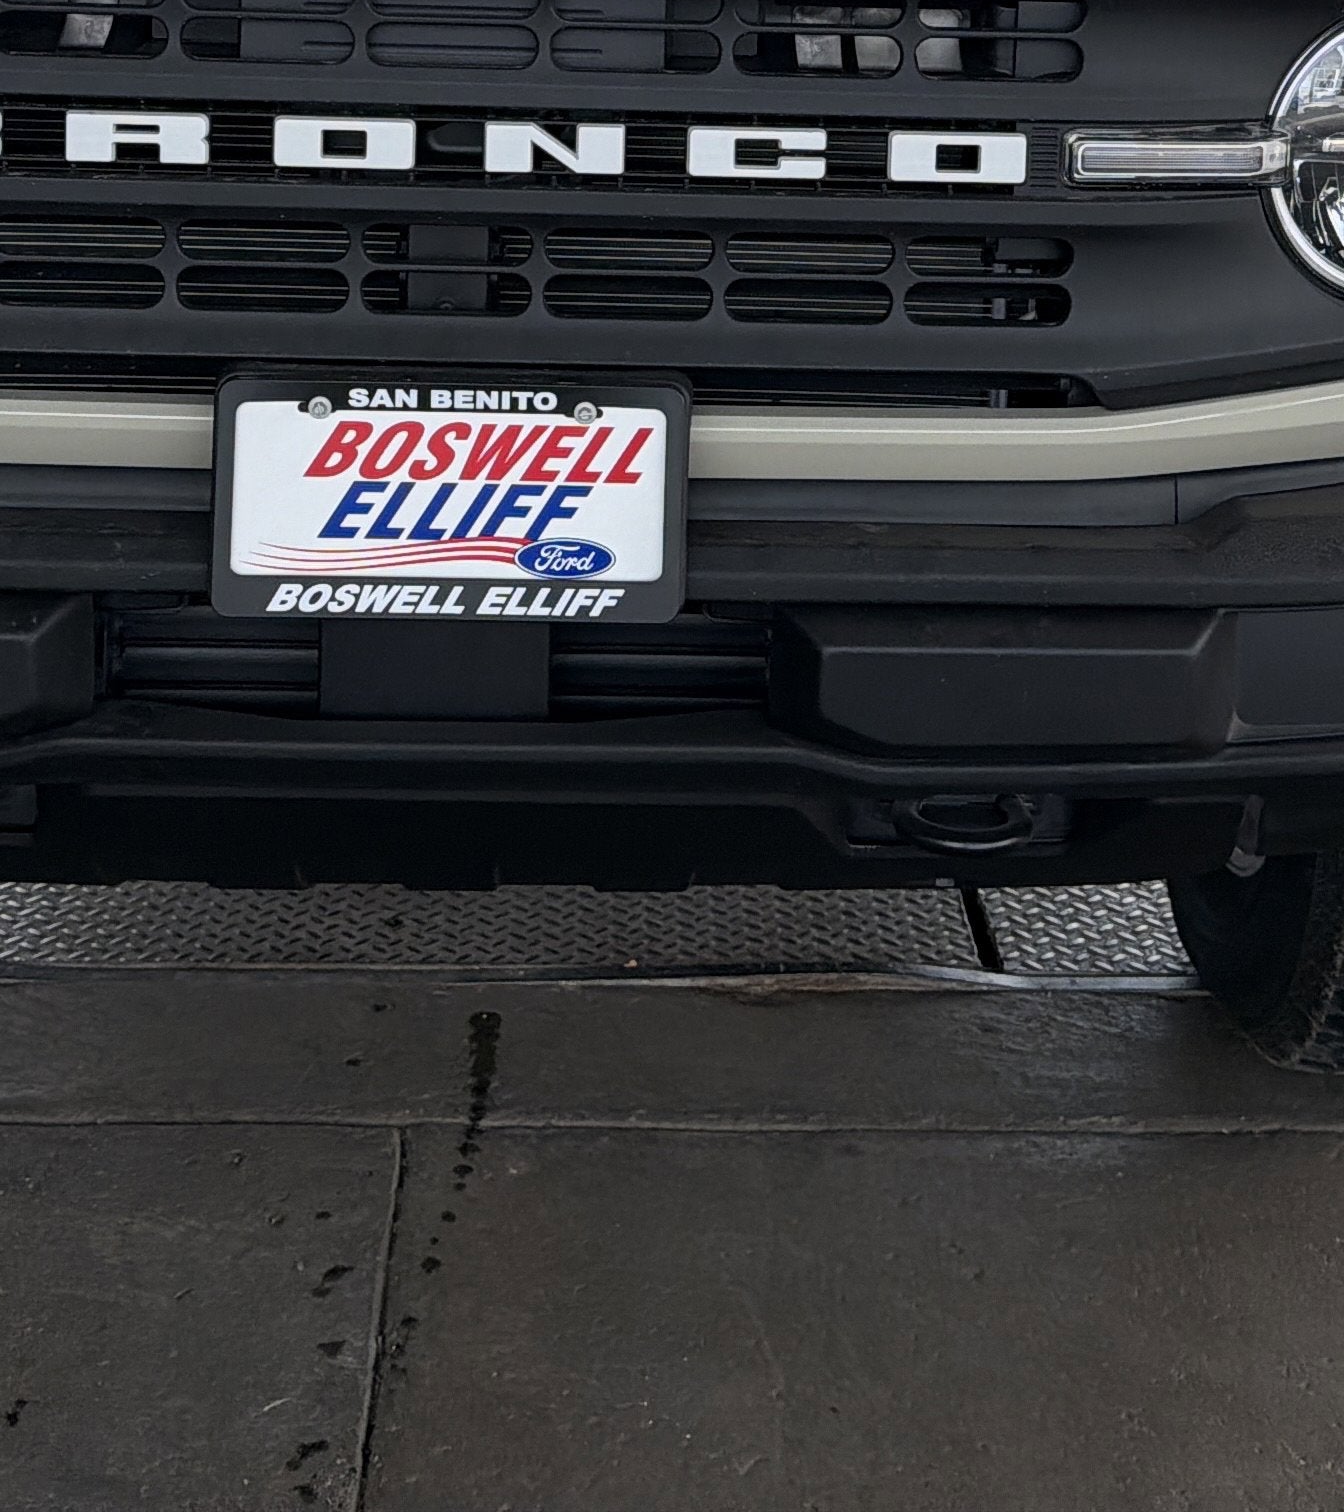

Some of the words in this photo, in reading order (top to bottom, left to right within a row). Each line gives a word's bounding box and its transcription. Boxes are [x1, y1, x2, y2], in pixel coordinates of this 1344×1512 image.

[348, 387, 417, 409] SAN
[429, 389, 558, 411] BENITO
[303, 420, 654, 484] BOSWELL
[318, 480, 595, 541] ELLIFF
[533, 544, 595, 572] Ford
[265, 583, 468, 615] BOSWELL
[476, 586, 625, 618] ELLIFF
